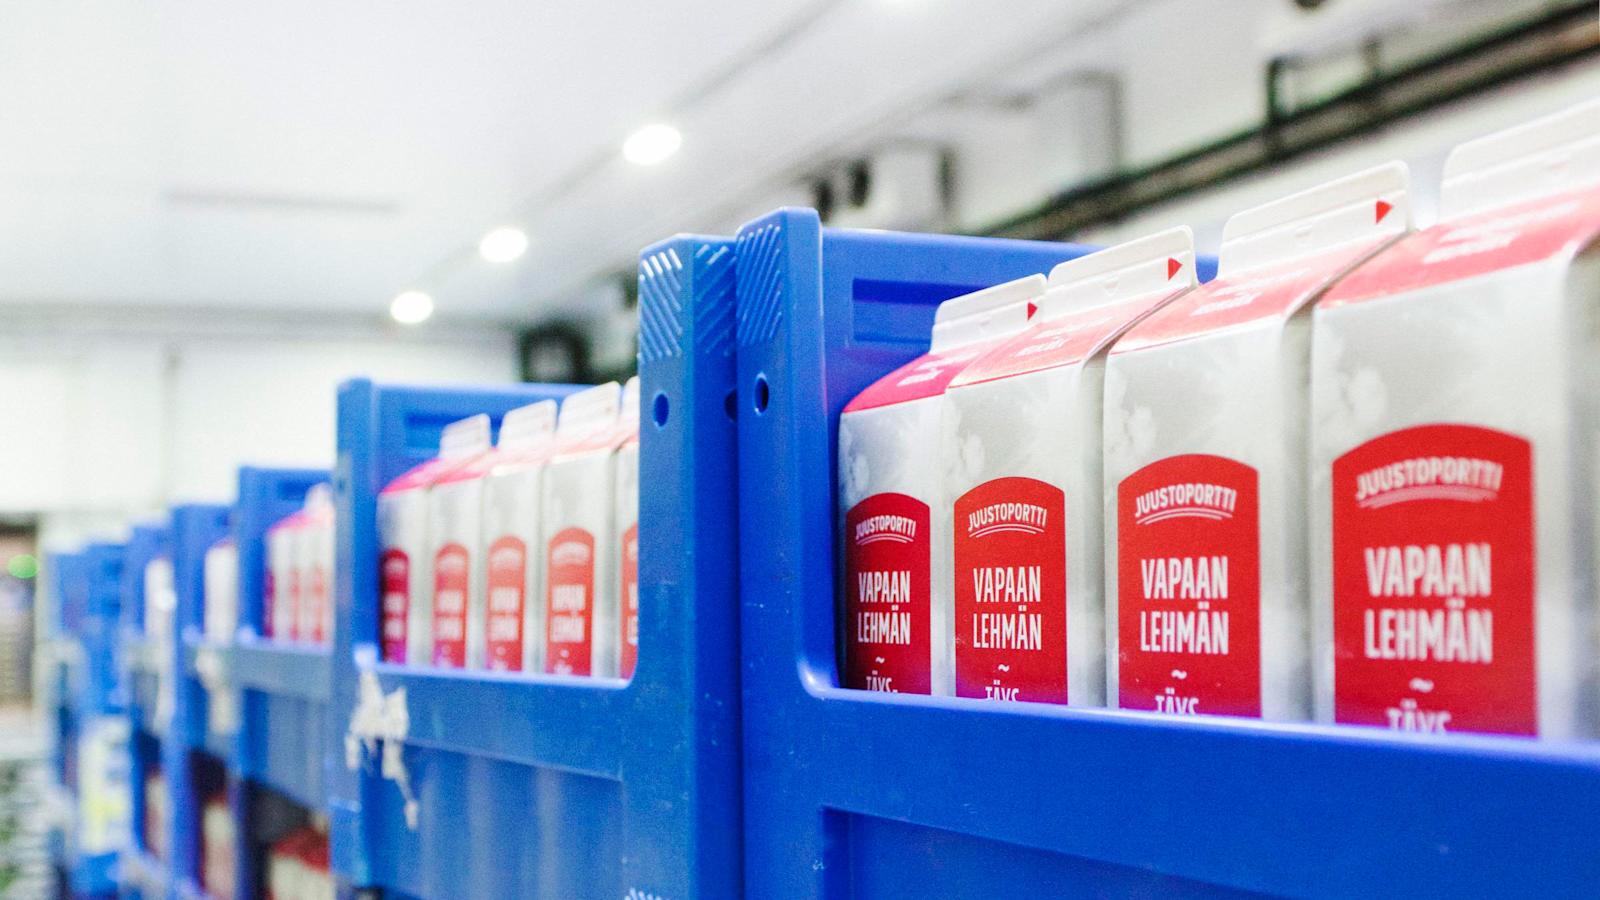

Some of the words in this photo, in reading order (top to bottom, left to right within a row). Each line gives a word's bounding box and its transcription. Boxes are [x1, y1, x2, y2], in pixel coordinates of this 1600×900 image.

[1356, 456, 1504, 500] JUUSTOPORTTI
[967, 502, 1048, 532] JUUSTOPORTTI
[1134, 483, 1237, 517] JUUSTOPORTTI
[855, 515, 917, 540] JUUSTOPORTTI
[858, 570, 911, 603] VAPAAN
[973, 566, 1042, 603] VAPAAN
[1141, 556, 1229, 600] VAPAAN
[1364, 542, 1492, 597] VAPAAN
[857, 605, 911, 645] LEHMÄN
[973, 605, 1042, 650] LEHMÄN
[1140, 601, 1230, 655] LEHMÄN
[1364, 598, 1493, 664] LEHMÄN
